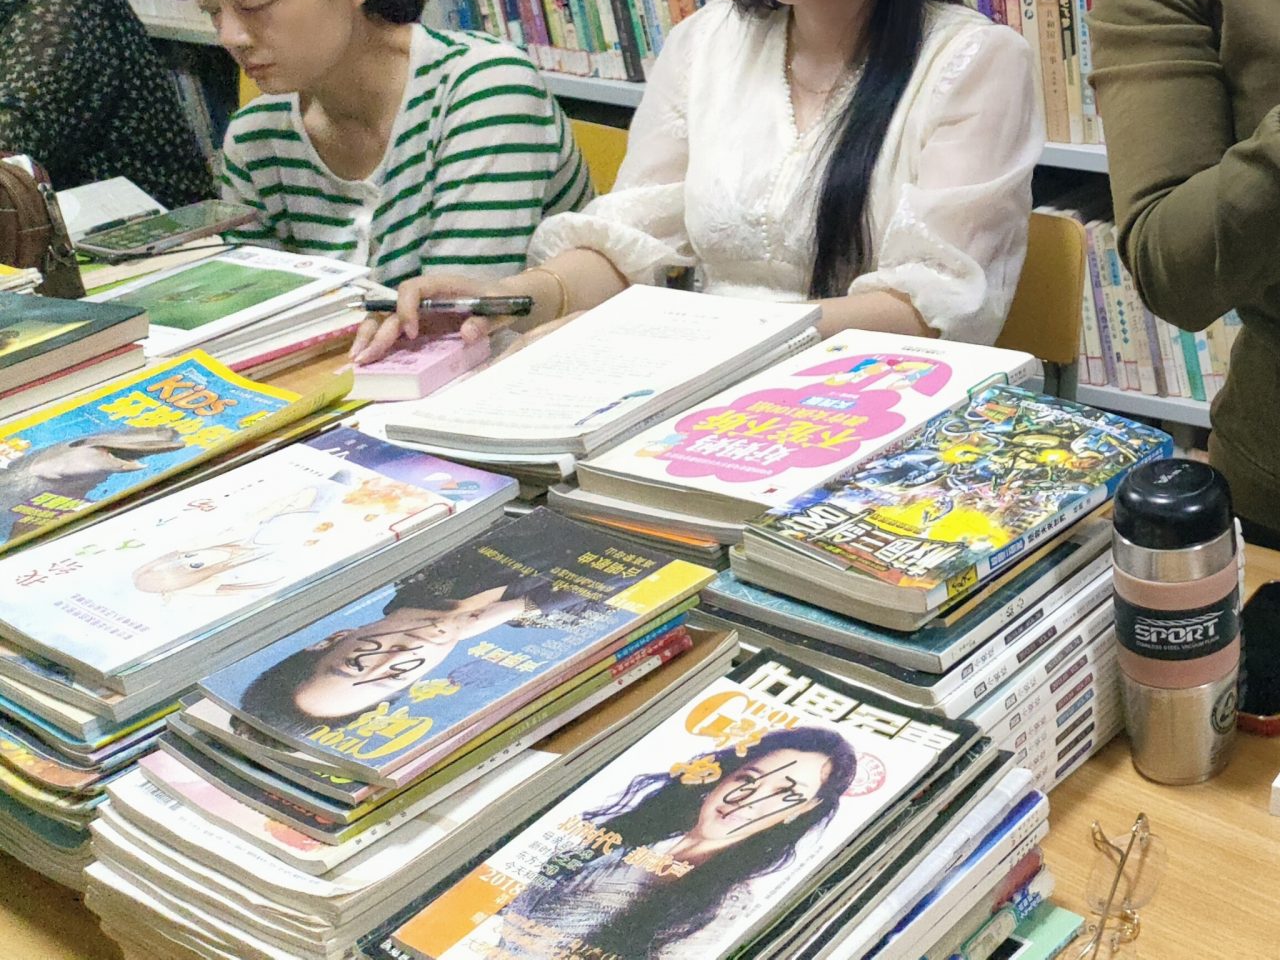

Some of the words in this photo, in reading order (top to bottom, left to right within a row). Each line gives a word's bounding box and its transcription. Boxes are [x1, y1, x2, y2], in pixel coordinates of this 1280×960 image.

[577, 550, 643, 580] 合唱歌曲
[1134, 617, 1219, 643] SPORT
[478, 868, 526, 895] 2018
